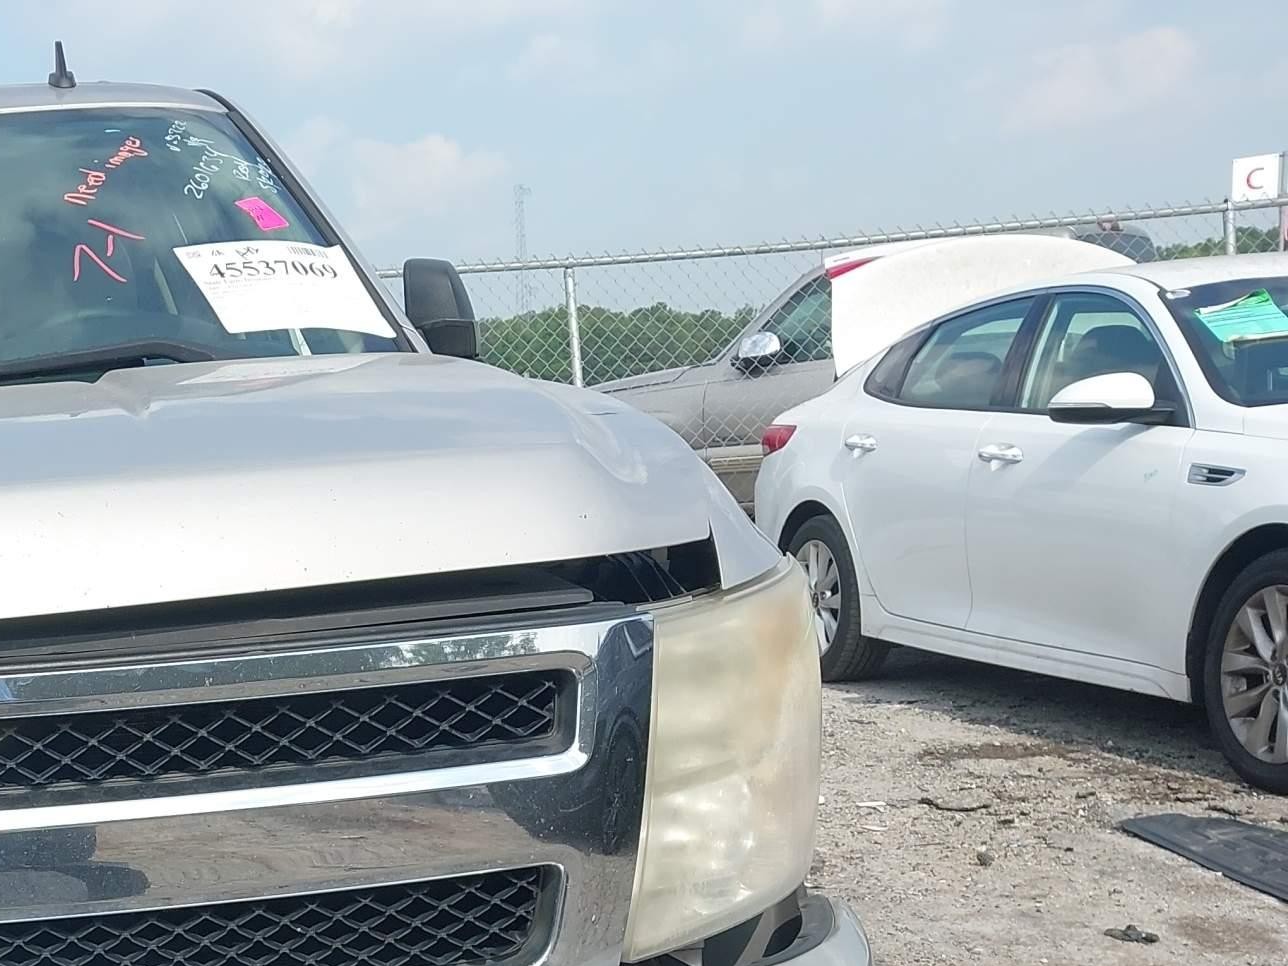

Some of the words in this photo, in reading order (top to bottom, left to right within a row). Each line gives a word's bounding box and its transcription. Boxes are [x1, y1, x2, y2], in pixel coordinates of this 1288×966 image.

[1246, 167, 1265, 190] C
[73, 218, 147, 283] 7-1
[208, 259, 339, 279] 45537069
